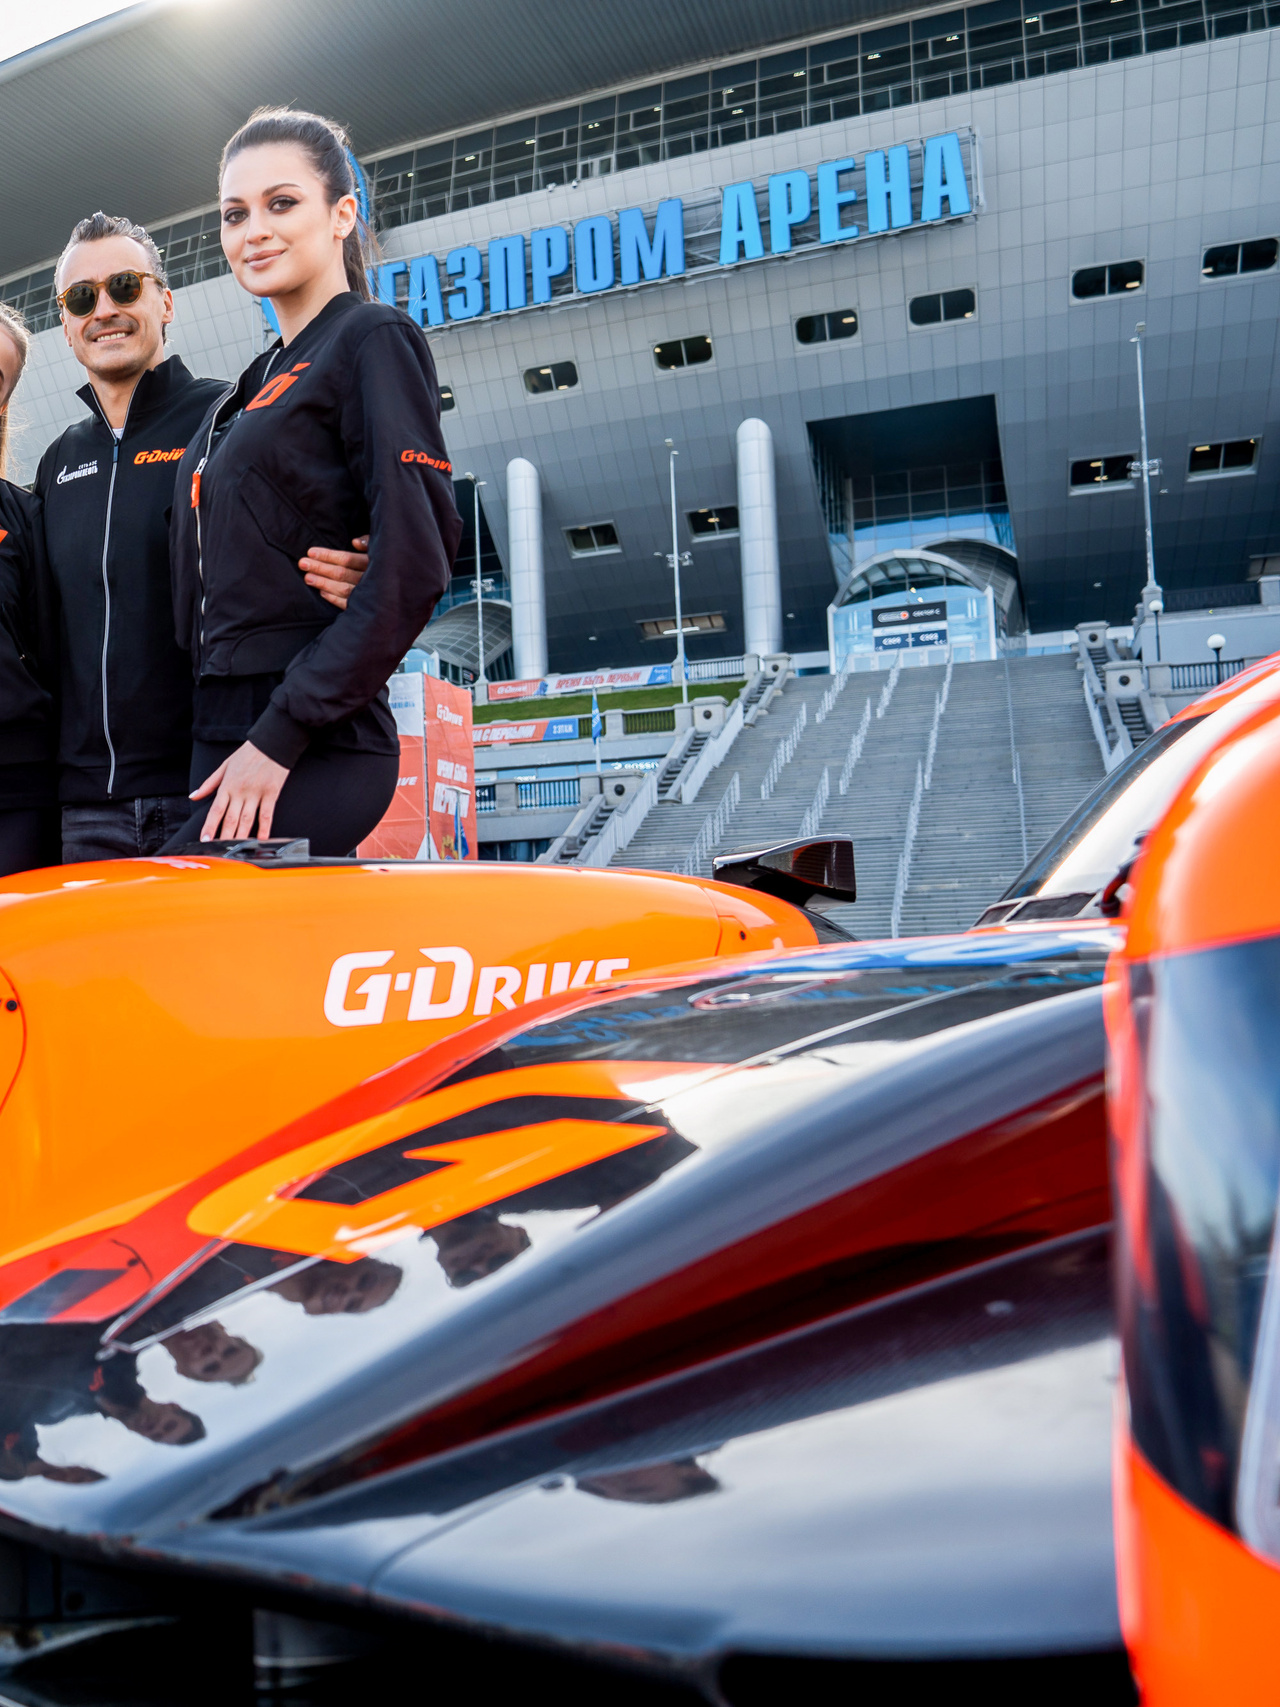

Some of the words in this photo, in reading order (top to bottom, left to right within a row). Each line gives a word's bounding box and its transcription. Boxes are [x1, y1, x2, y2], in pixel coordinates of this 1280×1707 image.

[377, 198, 686, 329] ГАЗПРОМ
[720, 131, 972, 266] АРЕНА
[133, 449, 186, 465] G-DRIV
